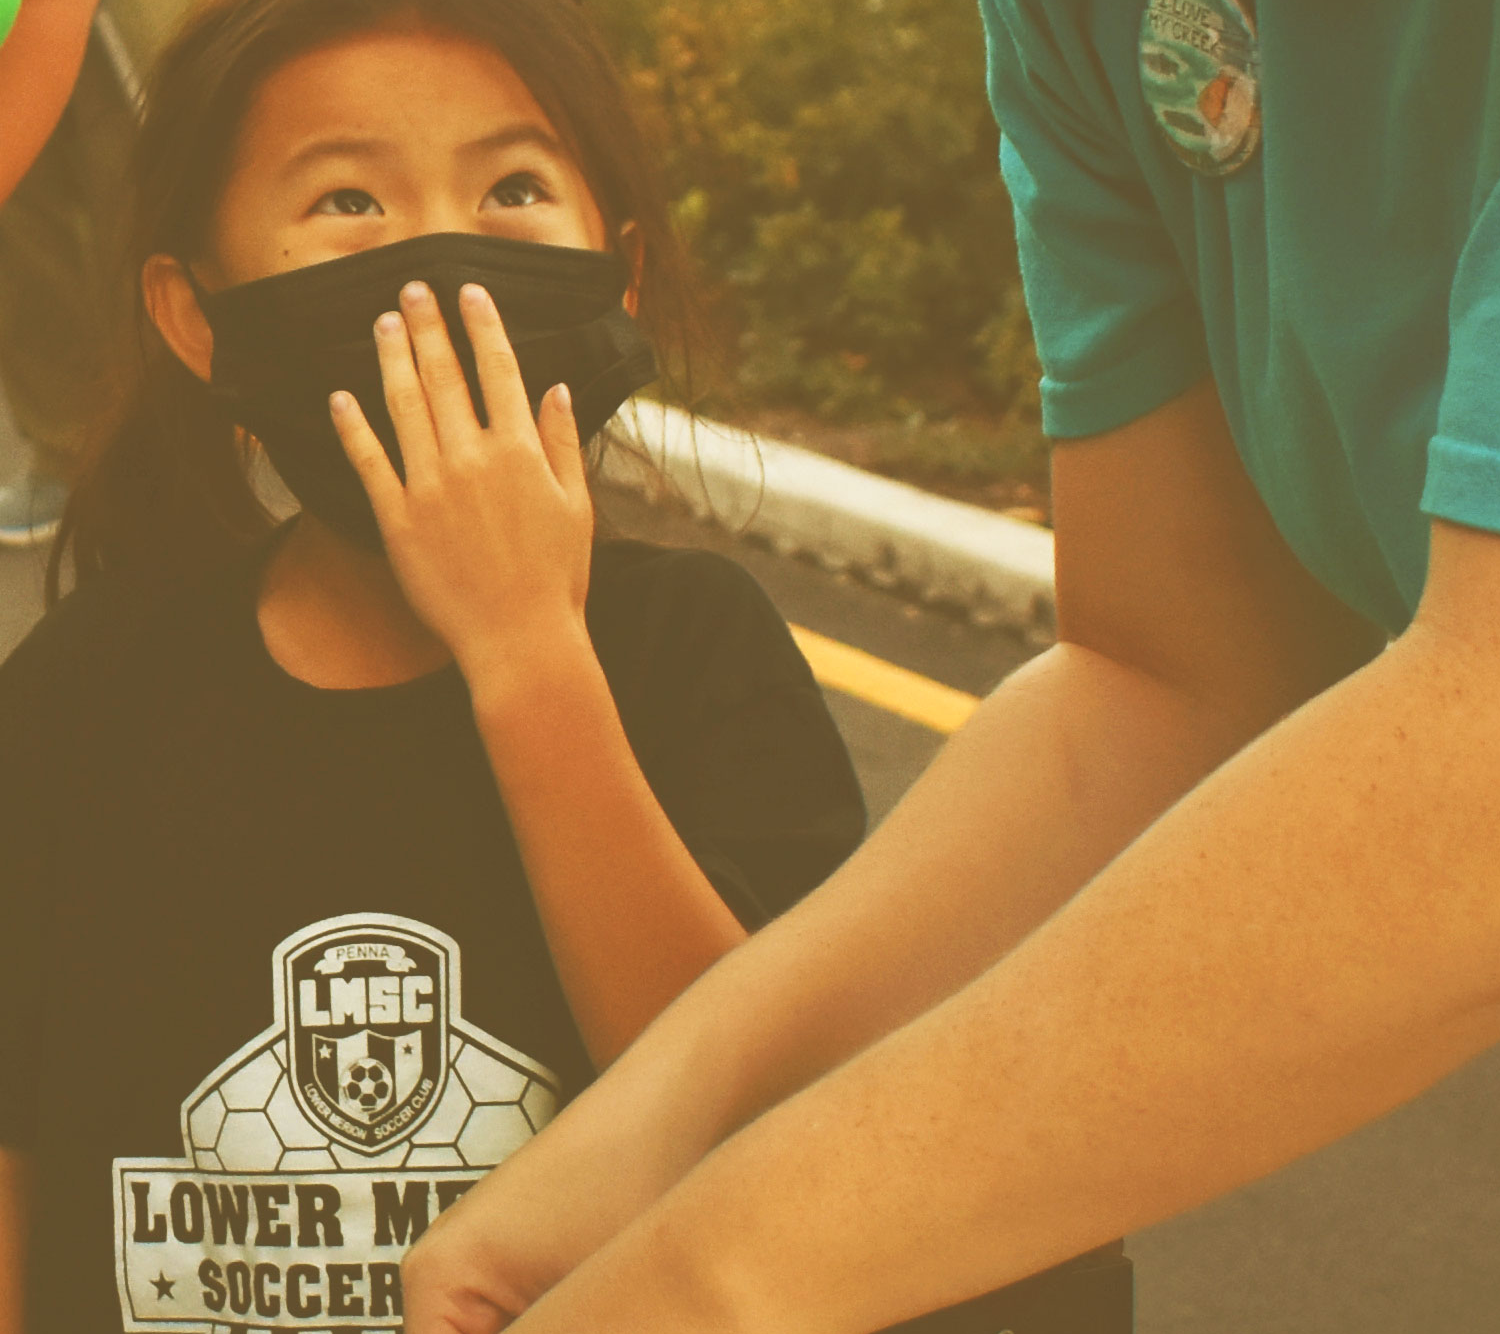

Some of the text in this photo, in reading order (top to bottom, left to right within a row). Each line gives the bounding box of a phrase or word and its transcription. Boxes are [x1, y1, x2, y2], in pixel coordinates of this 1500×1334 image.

[1147, 11, 1168, 32] MY
[335, 945, 391, 961] PENNA
[300, 975, 434, 1027] LMSC
[303, 1082, 332, 1118] LOWER
[373, 1105, 416, 1140] SOCCER
[411, 1077, 434, 1109] CLUB
[131, 1181, 345, 1248] LOWER
[199, 1258, 403, 1319] SOCCER
